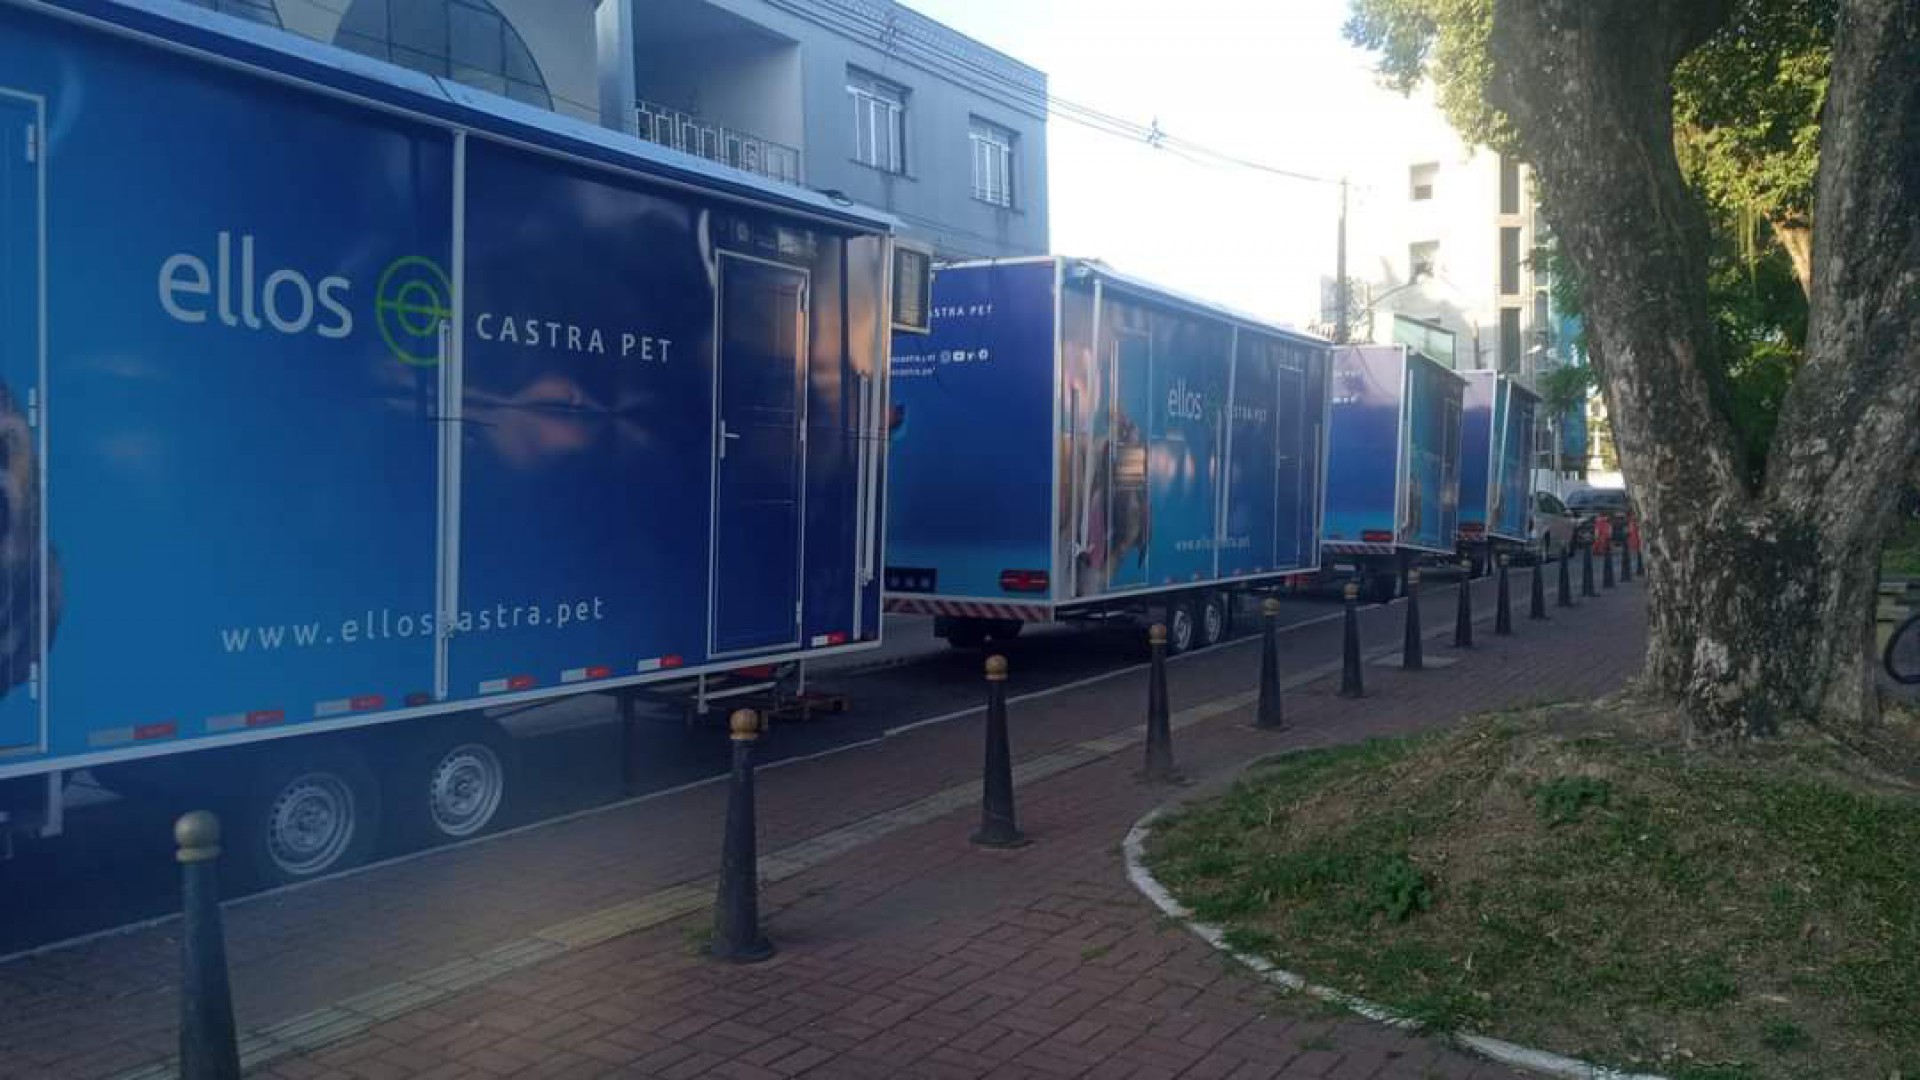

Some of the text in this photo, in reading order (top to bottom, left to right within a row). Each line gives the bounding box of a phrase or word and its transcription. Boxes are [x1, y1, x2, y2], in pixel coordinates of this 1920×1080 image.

[157, 231, 353, 338] ellos
[475, 313, 673, 363] CASTRA PET
[930, 306, 965, 318] STRA
[221, 597, 605, 652] www.ellosastra.pet
